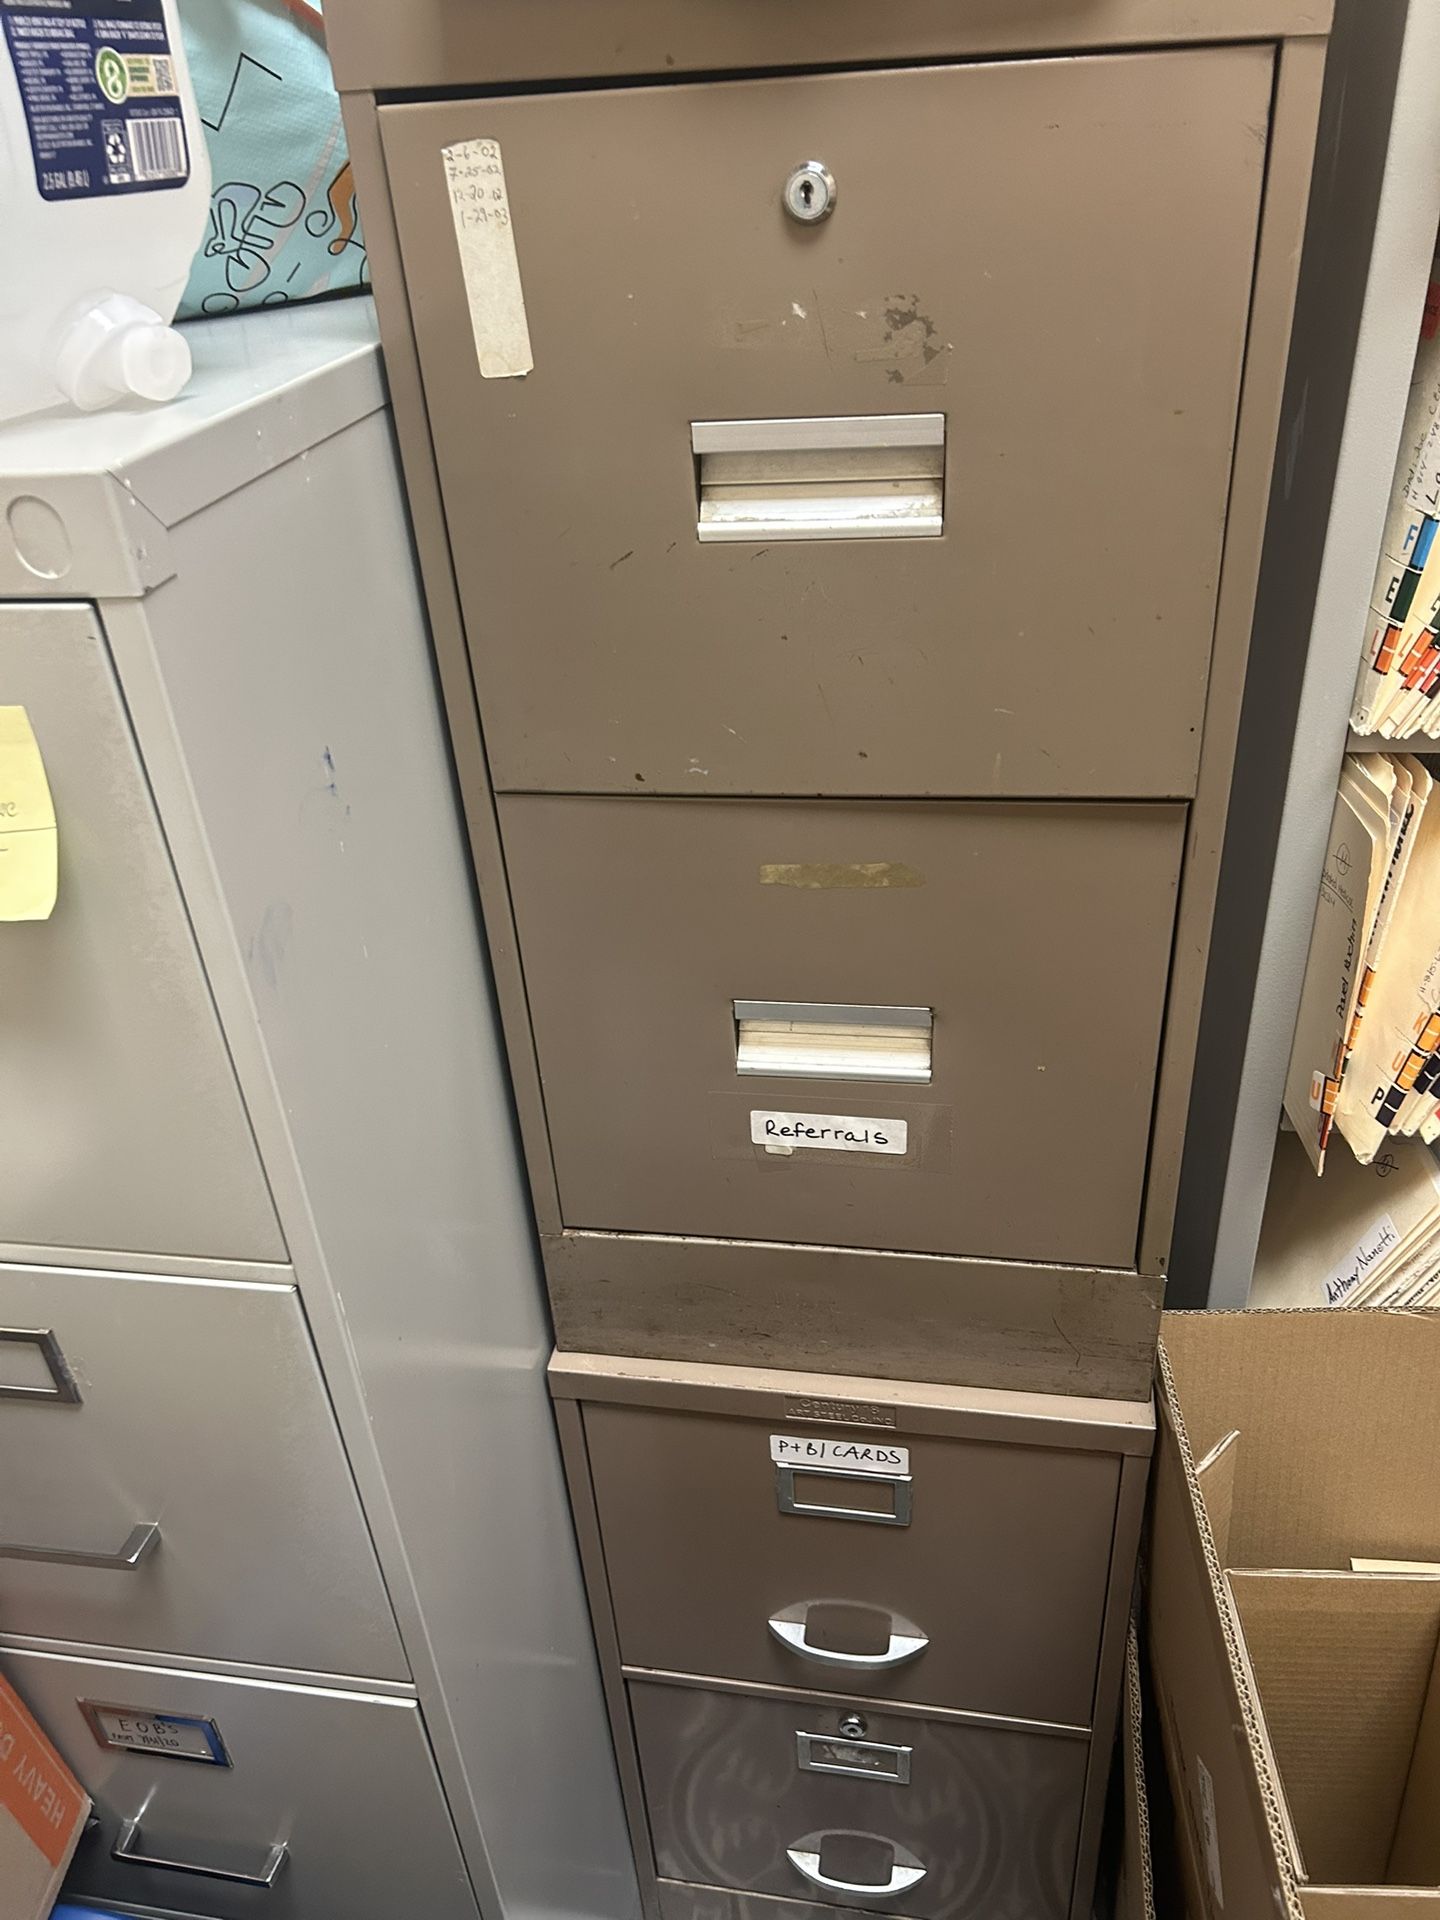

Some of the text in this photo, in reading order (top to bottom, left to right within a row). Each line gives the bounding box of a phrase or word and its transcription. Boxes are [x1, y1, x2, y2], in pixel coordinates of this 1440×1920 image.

[1402, 524, 1418, 551] F
[1385, 576, 1400, 603] E
[1412, 1011, 1428, 1035] K
[1370, 1086, 1385, 1105] P
[765, 1119, 889, 1145] Referrals
